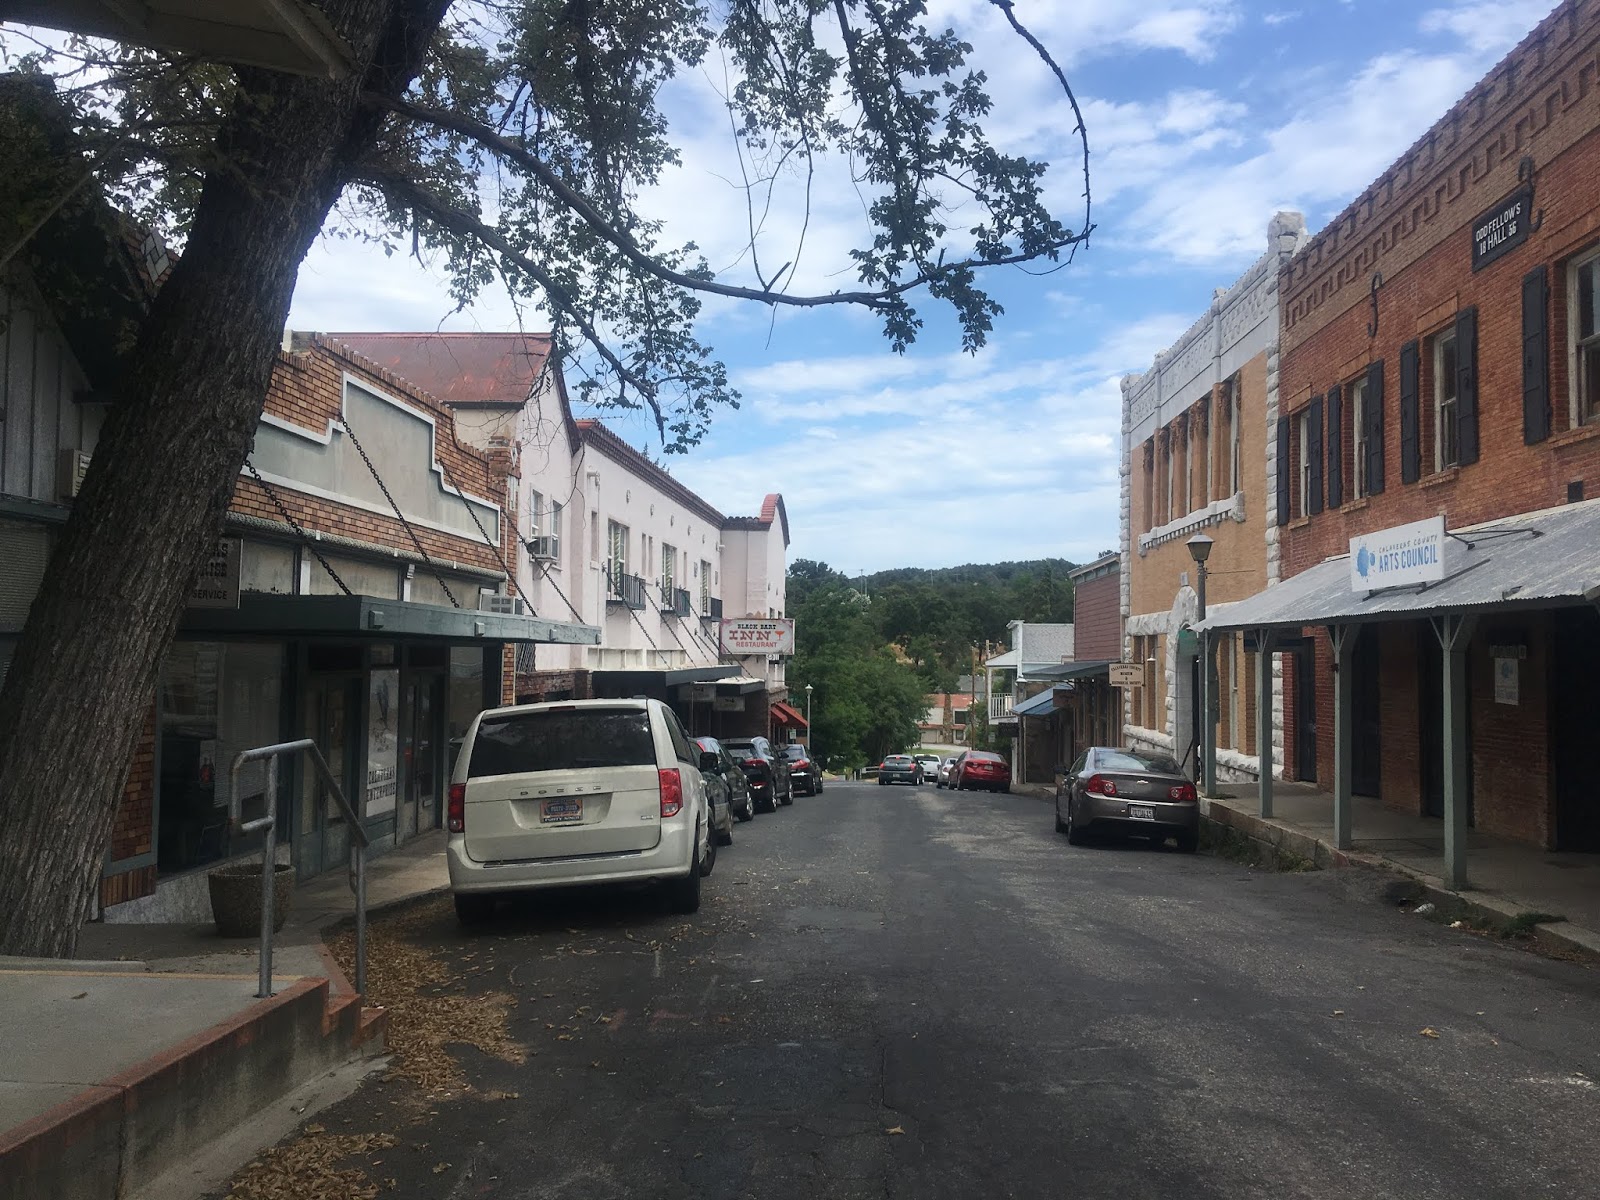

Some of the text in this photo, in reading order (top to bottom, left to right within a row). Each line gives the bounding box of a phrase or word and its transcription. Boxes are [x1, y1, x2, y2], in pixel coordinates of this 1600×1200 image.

[1487, 225, 1507, 251] HALL
[1413, 534, 1438, 546] COUNTY
[1379, 544, 1438, 573] ARTS COUNCIL
[729, 630, 771, 640] INN
[520, 785, 602, 796] DODGE
